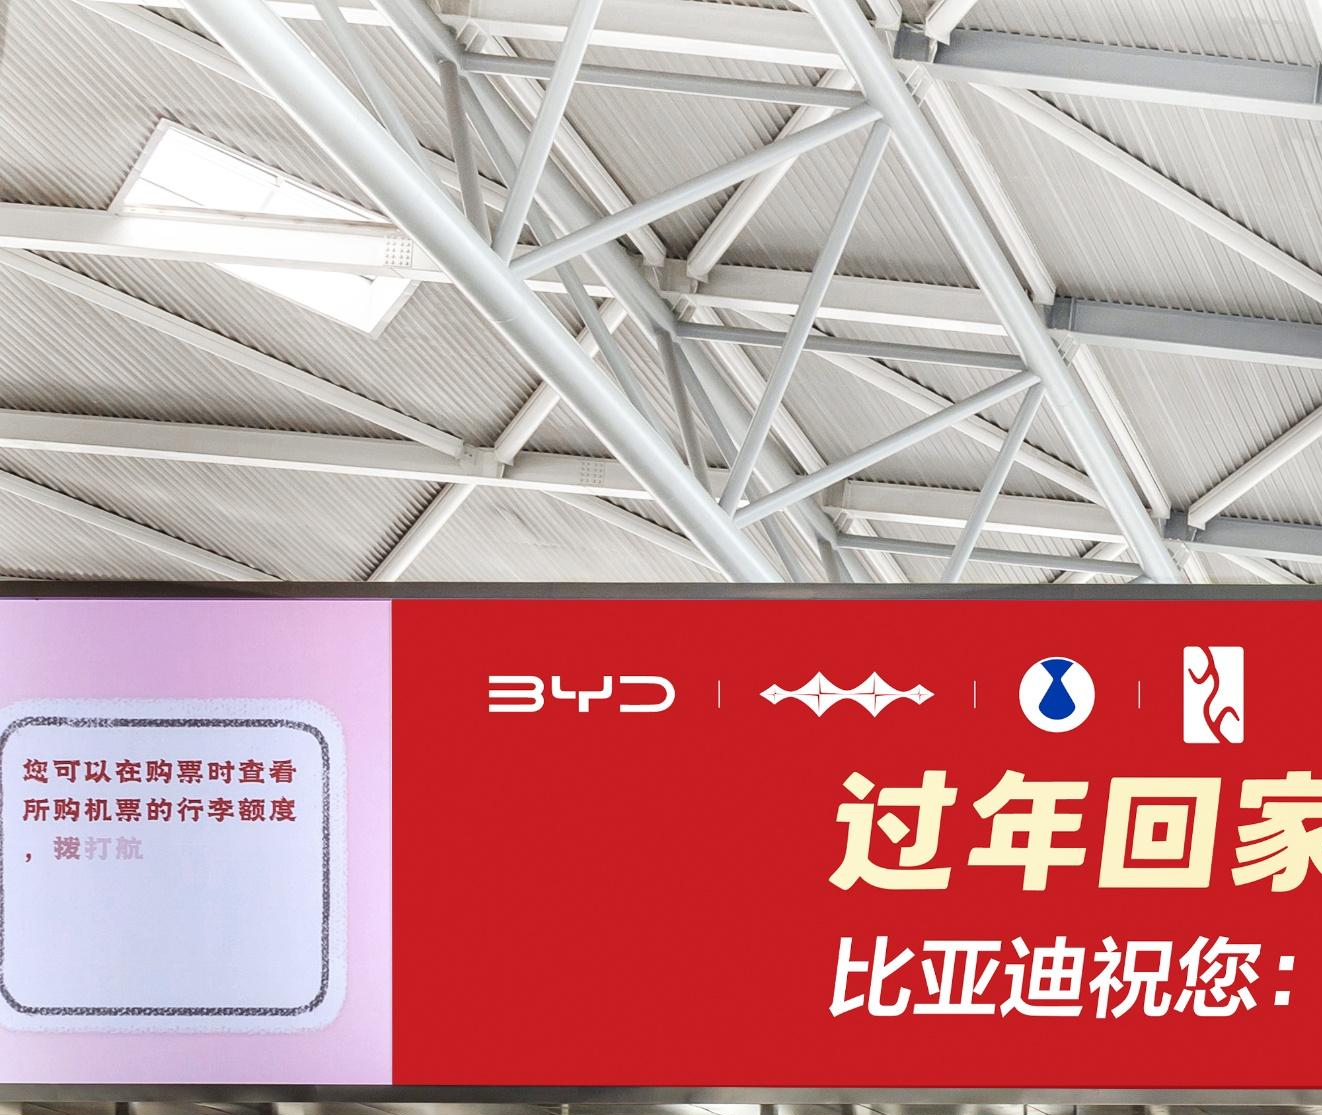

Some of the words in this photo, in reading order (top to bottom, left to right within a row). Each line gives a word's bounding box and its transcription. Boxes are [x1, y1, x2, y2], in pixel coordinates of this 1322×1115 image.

[489, 676, 675, 712] BYD
[23, 759, 296, 784] 您可以在购票时查看
[23, 798, 296, 822] 所购机票的行李额度
